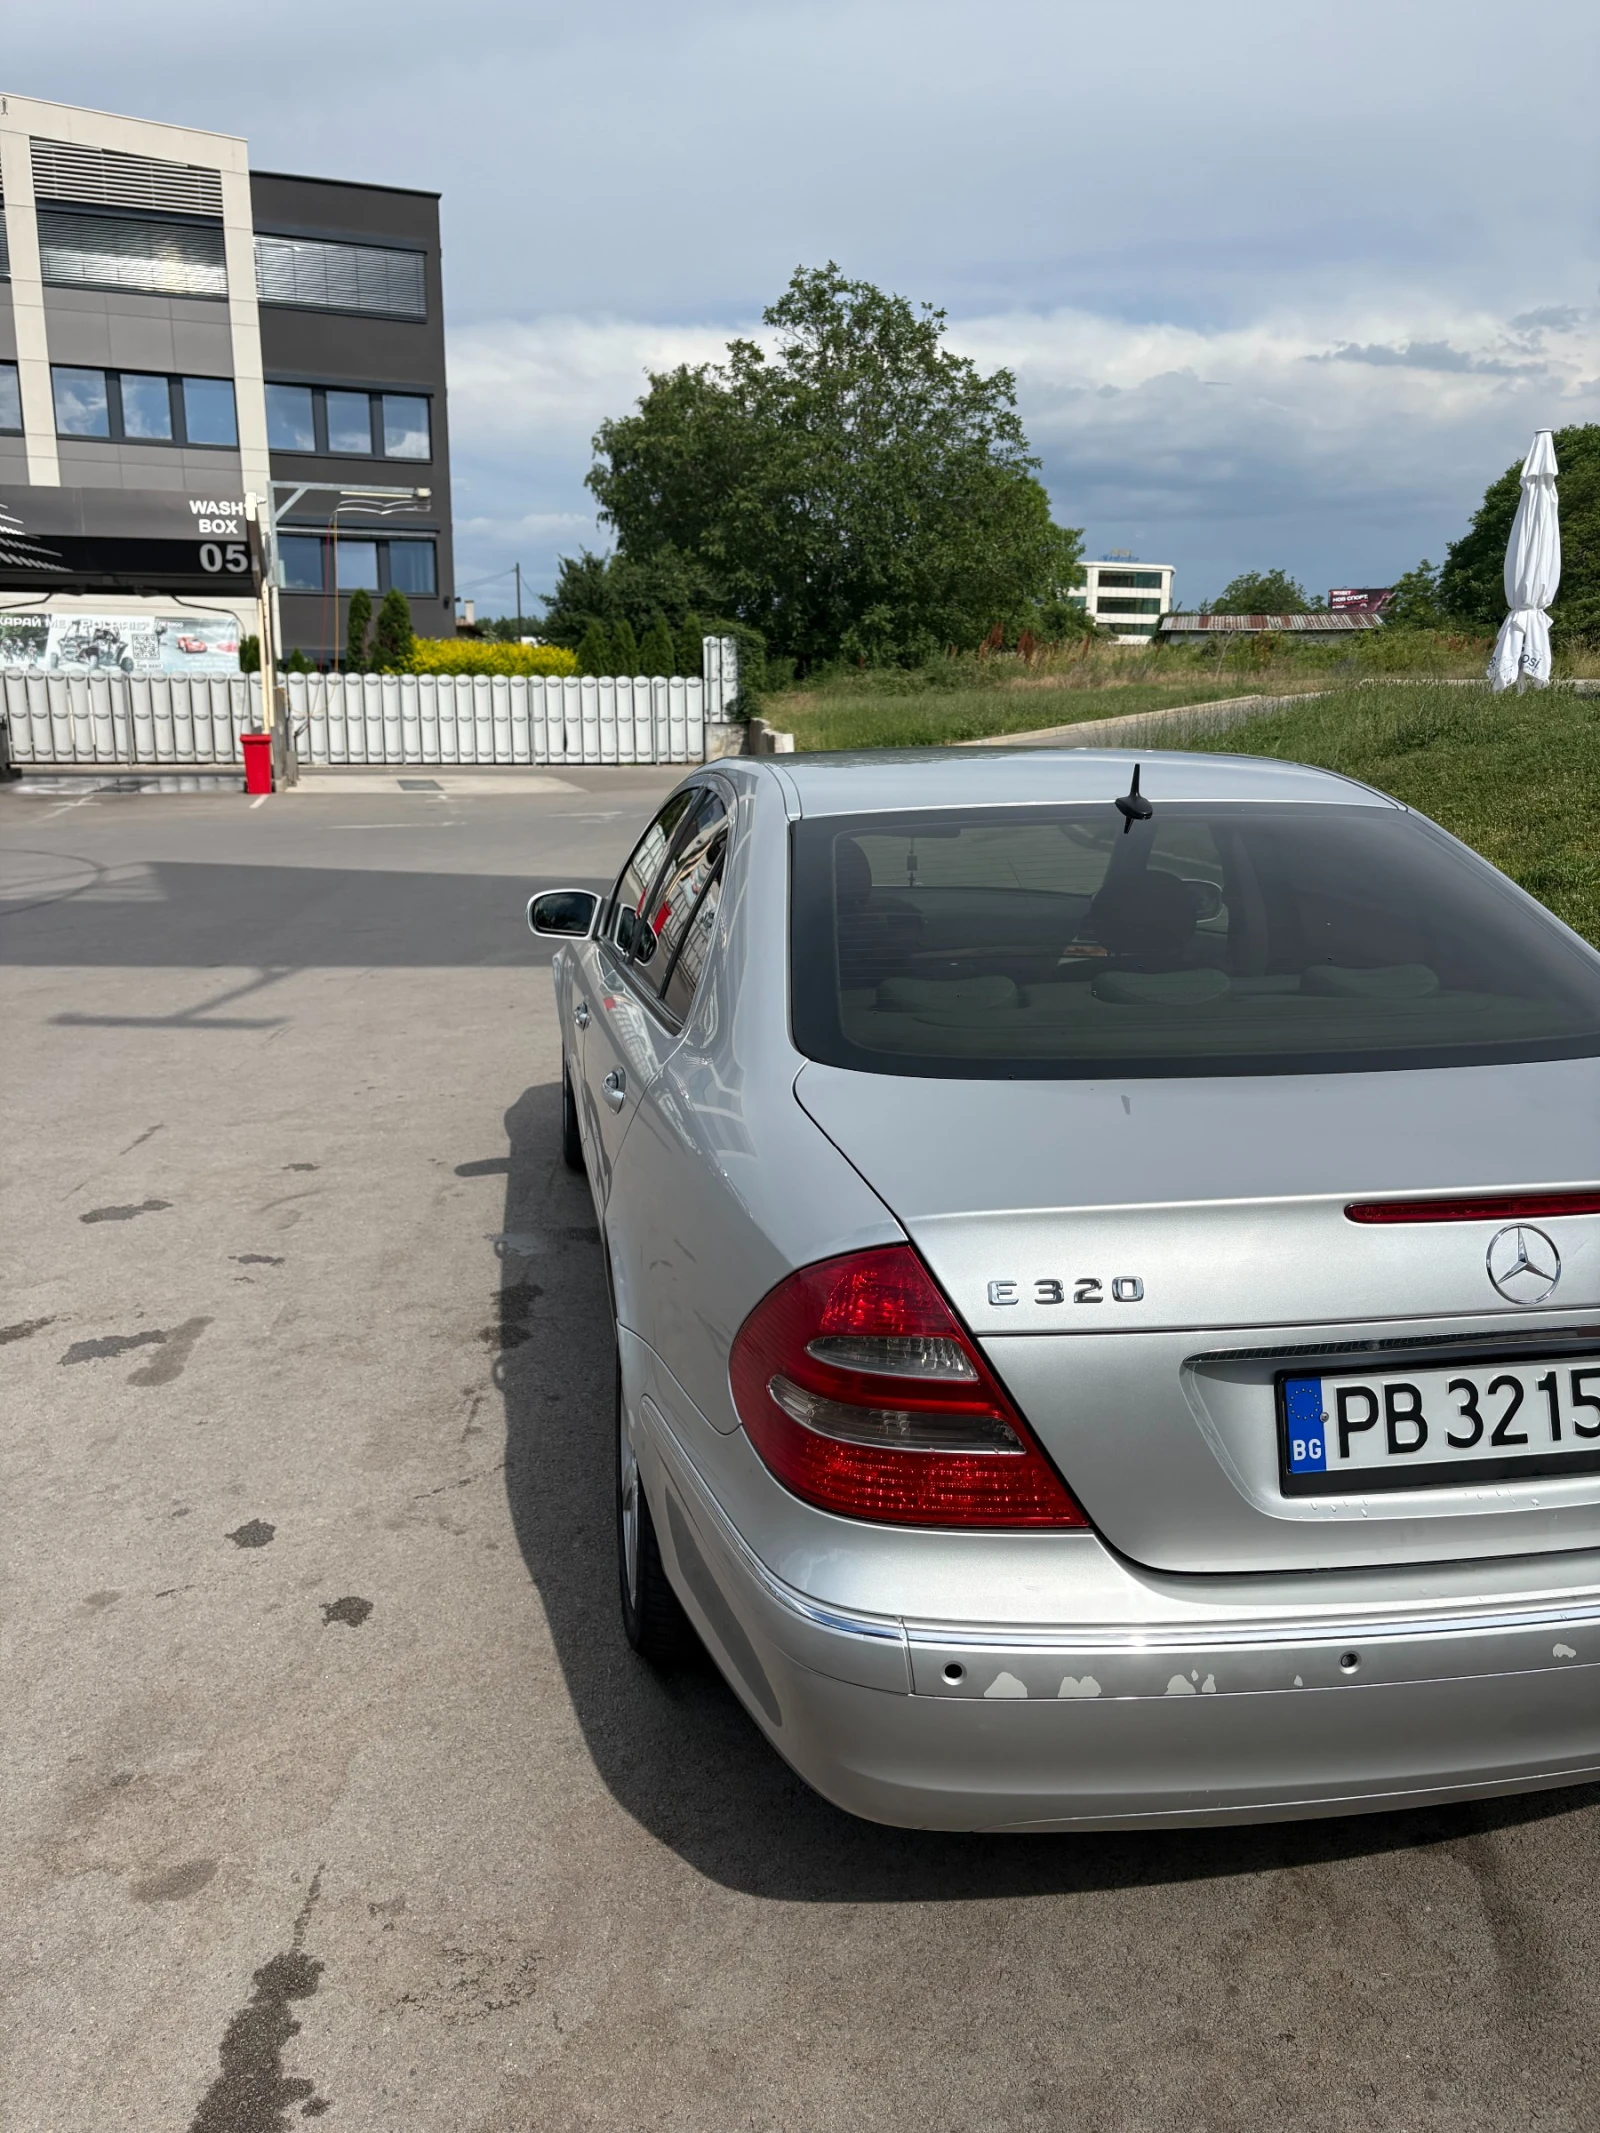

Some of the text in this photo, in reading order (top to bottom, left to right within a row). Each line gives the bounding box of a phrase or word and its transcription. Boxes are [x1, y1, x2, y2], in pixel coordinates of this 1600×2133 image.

[189, 499, 244, 516] WASH
[199, 518, 239, 534] BOX
[199, 542, 249, 573] 05
[987, 1275, 1144, 1306] E 320
[1335, 1367, 1600, 1459] PB 3215
[1292, 1438, 1322, 1462] BG
